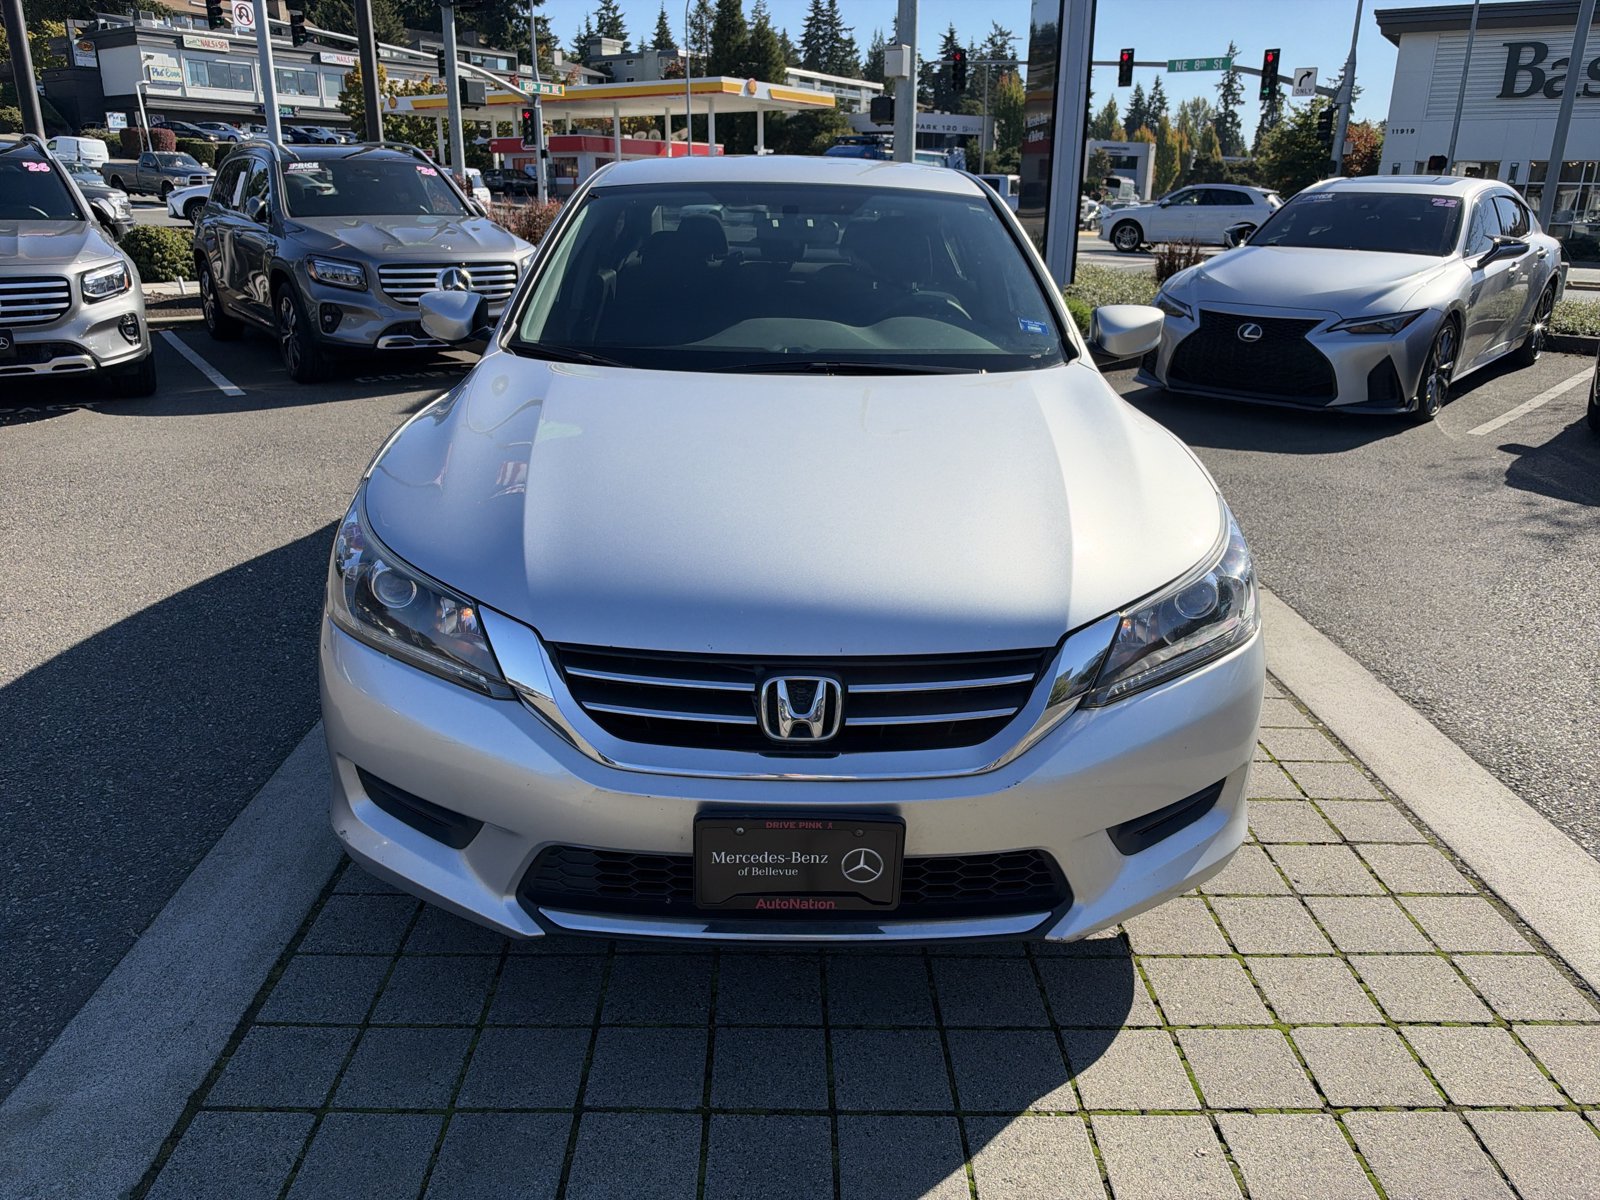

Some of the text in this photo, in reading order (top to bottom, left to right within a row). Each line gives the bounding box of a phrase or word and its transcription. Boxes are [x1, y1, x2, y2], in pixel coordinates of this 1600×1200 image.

[1175, 59, 1223, 71] NE 8th St
[765, 821, 823, 830] DRIVE PINK
[711, 851, 829, 864] Mercedes-Benz
[738, 867, 799, 876] of Bellevue
[755, 898, 835, 910] AutoNation
